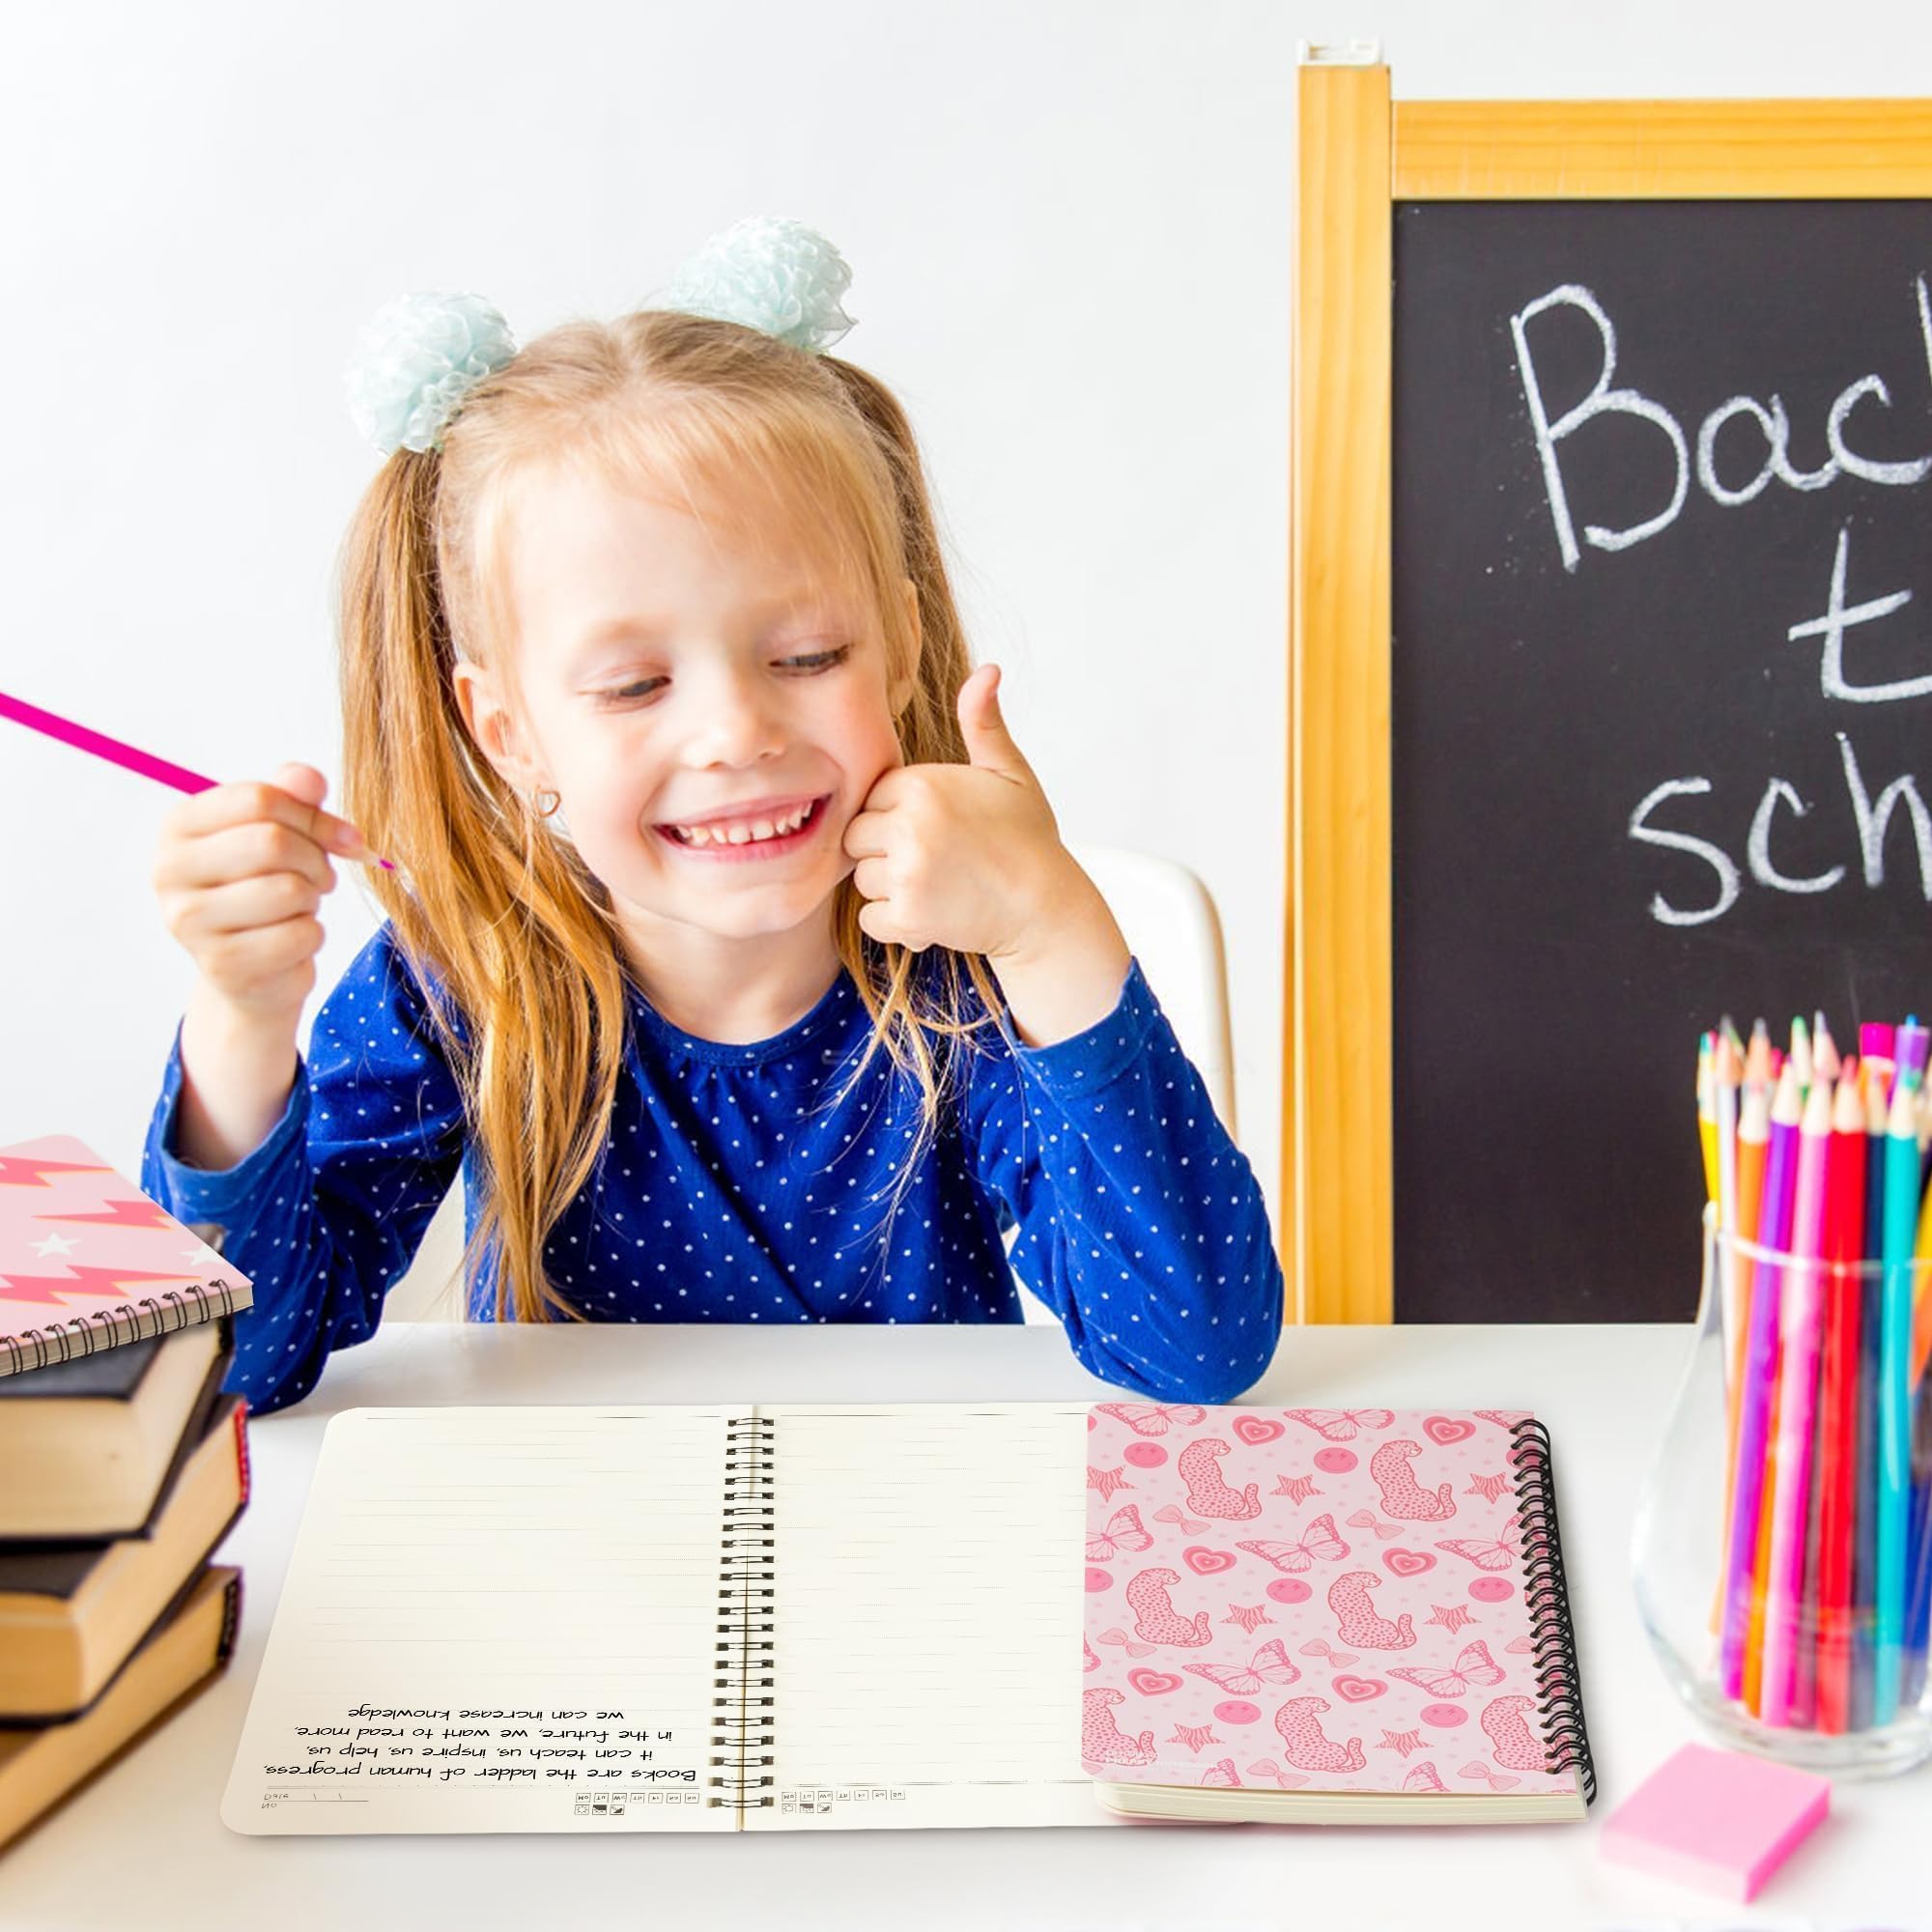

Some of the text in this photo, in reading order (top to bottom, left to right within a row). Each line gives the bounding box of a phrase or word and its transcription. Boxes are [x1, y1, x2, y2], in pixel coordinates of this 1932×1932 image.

[348, 1703, 625, 1722] we can increase knowledge
[294, 1726, 672, 1744] in the future, we want to read more,
[306, 1742, 653, 1761] it can teach us, inspire us, help us,
[263, 1760, 696, 1782] Books are the ladder of human progress,
